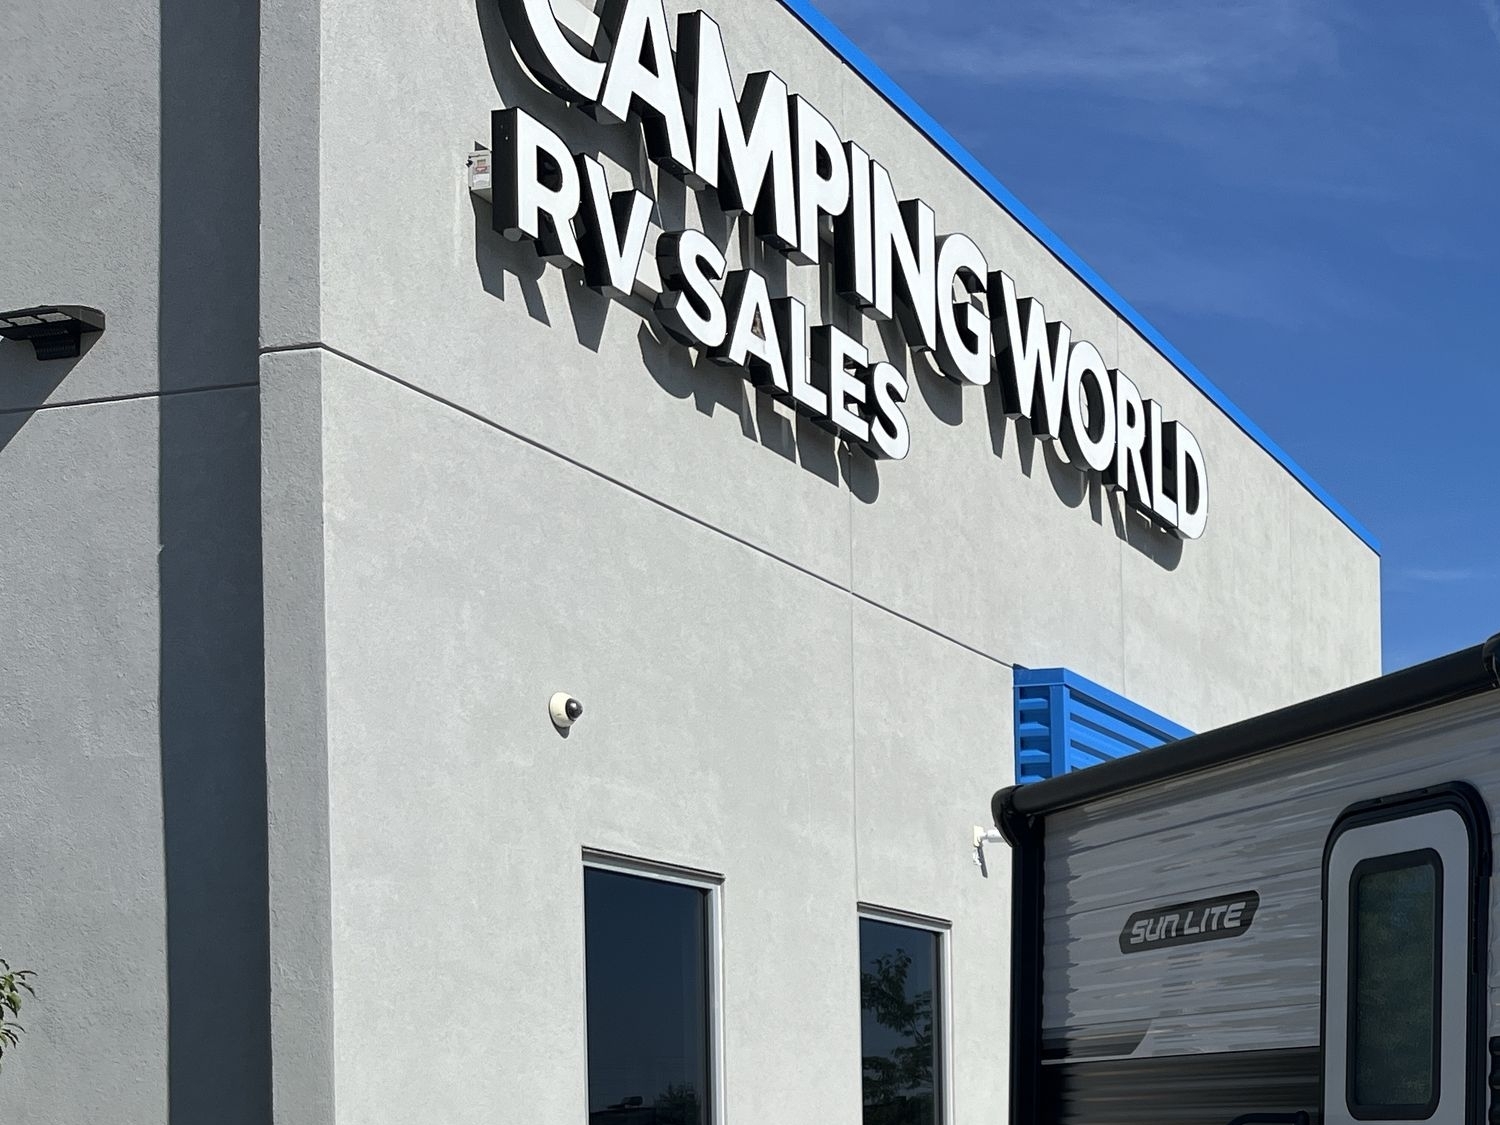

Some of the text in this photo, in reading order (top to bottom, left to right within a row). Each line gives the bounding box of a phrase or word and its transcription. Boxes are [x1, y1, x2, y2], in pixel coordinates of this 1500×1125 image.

[516, 107, 909, 460] RV SALES
[999, 270, 1208, 540] WORLD
[1130, 901, 1246, 944] SUN LITE
